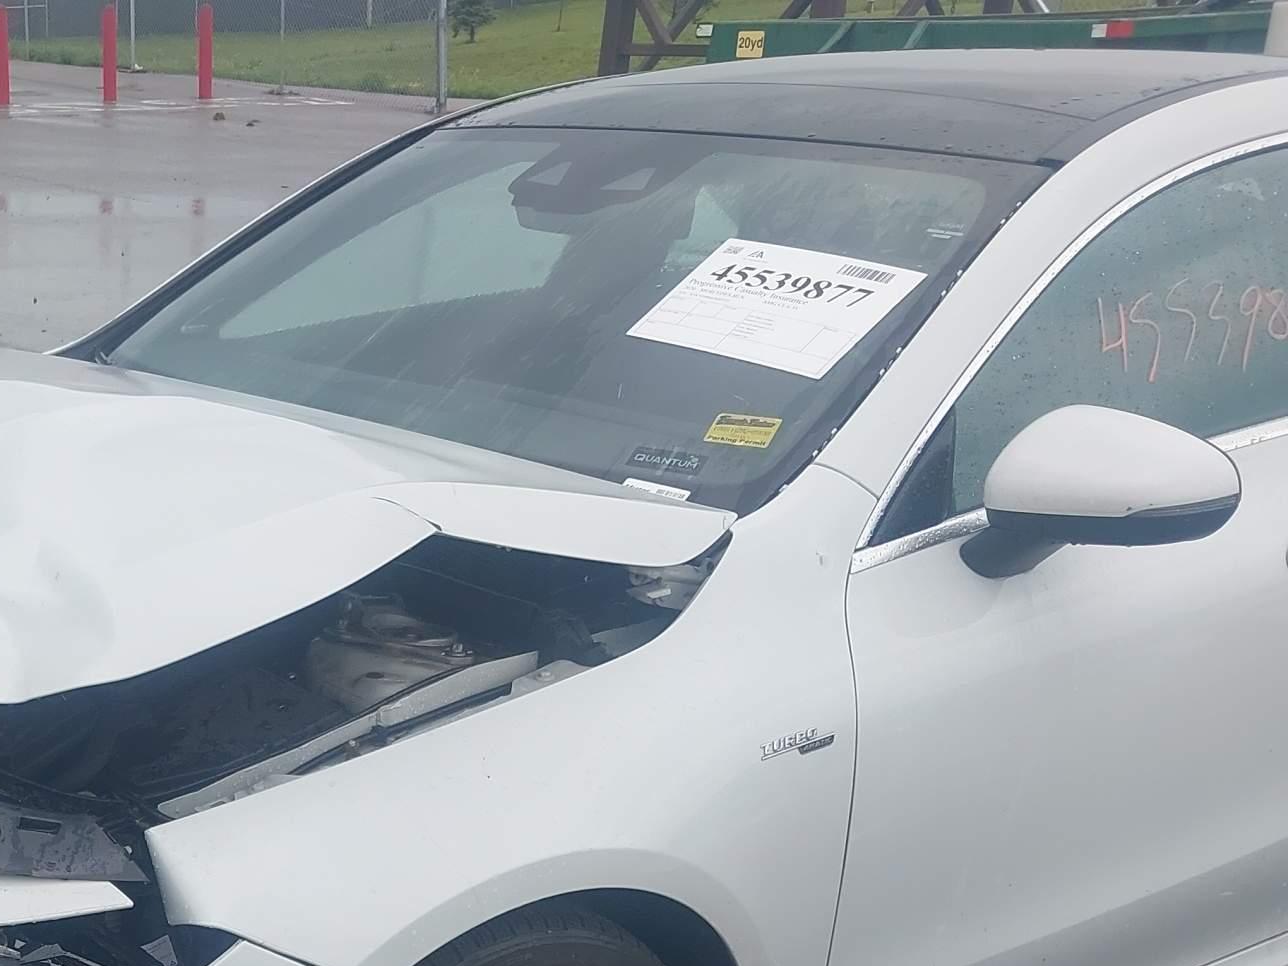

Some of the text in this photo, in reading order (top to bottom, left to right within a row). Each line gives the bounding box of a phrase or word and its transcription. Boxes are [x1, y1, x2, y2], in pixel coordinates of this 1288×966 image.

[738, 36, 764, 52] 20yd
[688, 278, 733, 291] Progressive
[734, 285, 770, 298] Casualty
[770, 293, 809, 306] Insurance
[710, 263, 875, 308] 45539877
[707, 435, 737, 444] Parking
[633, 453, 700, 470] QUANTUM
